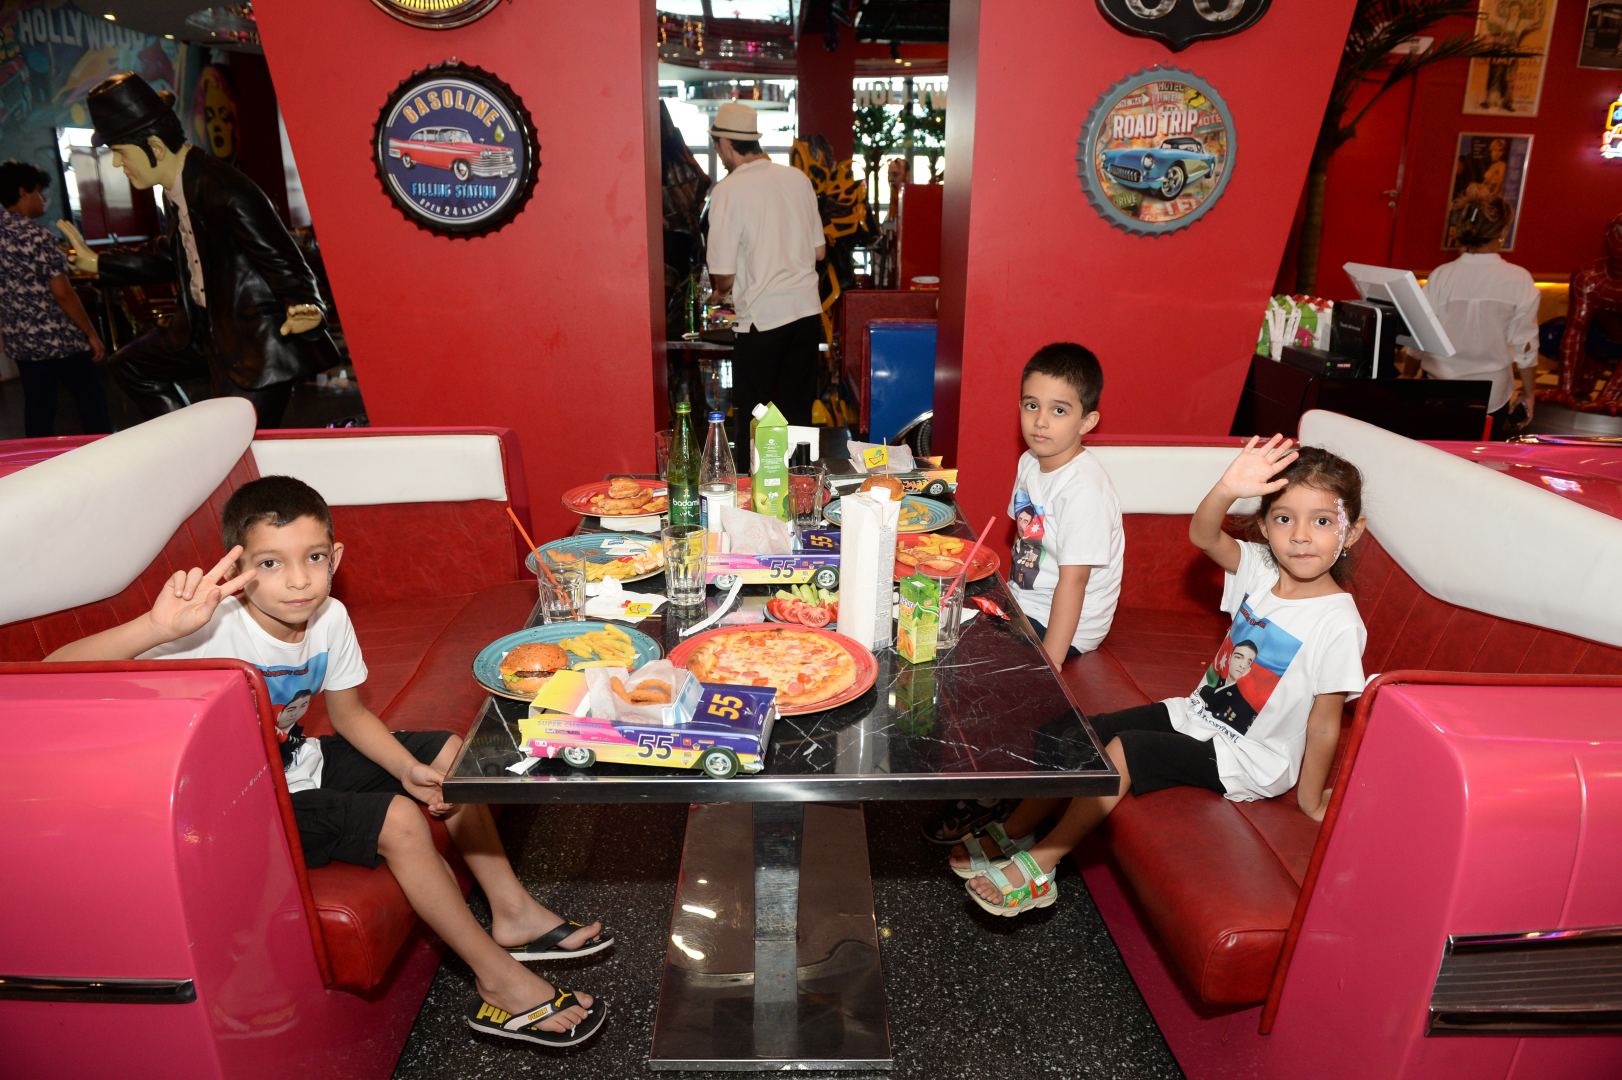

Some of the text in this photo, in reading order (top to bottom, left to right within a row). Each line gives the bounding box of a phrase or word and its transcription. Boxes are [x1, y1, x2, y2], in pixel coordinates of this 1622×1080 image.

[402, 89, 500, 128] GASOLINE
[1113, 108, 1199, 140] ROAD TRIP
[411, 183, 497, 199] FILLING STATION
[420, 198, 441, 213] OPEN
[444, 206, 459, 216] 24
[810, 534, 833, 548] 55
[769, 559, 797, 579] 55
[707, 693, 744, 720] 55
[636, 733, 674, 760] 55
